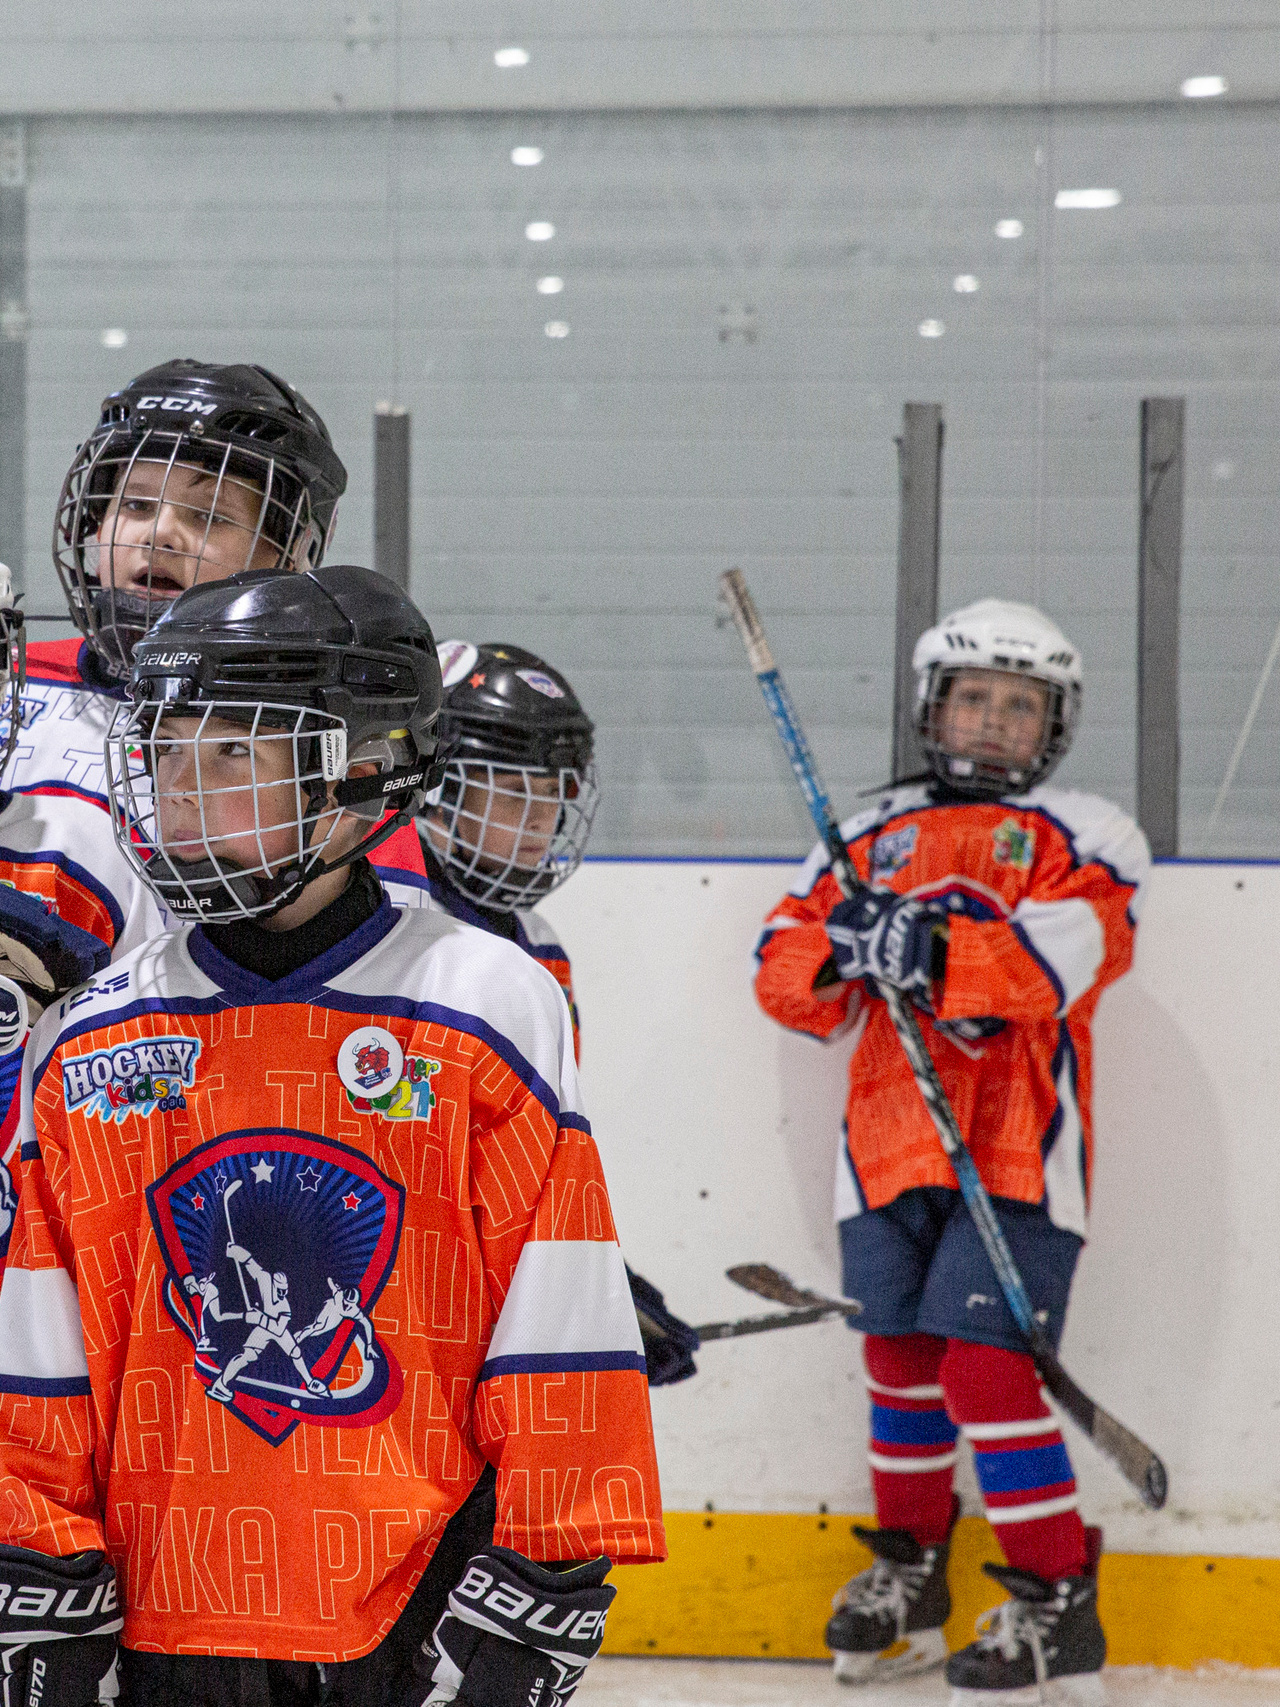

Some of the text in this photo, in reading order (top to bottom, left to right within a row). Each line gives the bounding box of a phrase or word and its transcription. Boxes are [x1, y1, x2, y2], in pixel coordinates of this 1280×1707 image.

[136, 396, 218, 416] CCM
[165, 897, 213, 909] AUER
[63, 1040, 196, 1107] HOCKEY
[105, 1073, 170, 1110] kids
